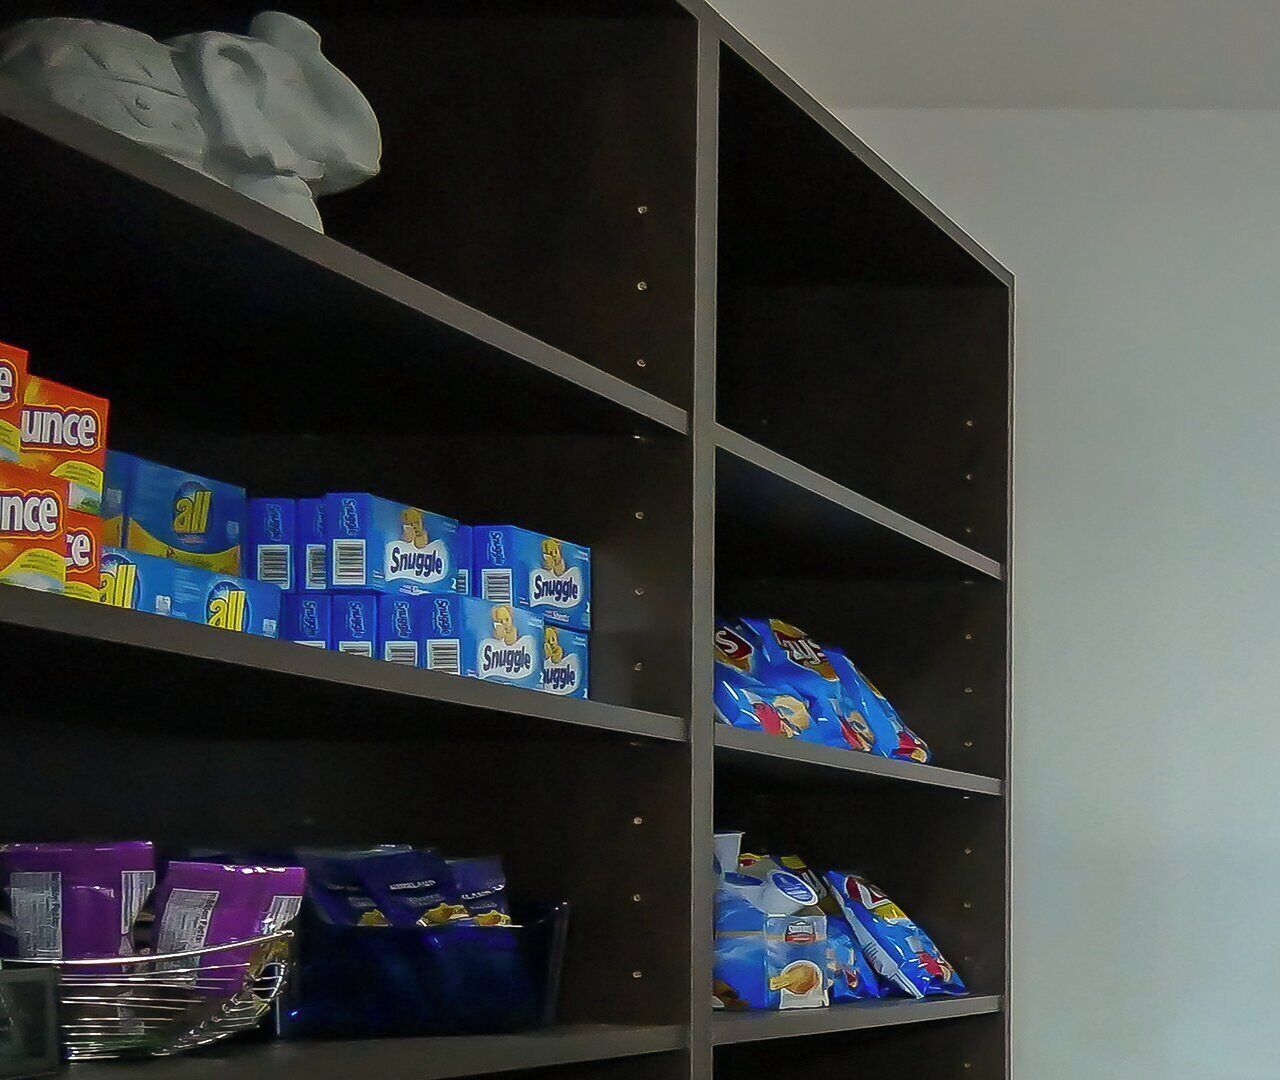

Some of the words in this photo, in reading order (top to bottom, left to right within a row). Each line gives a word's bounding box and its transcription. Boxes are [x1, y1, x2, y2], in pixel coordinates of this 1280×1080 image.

[173, 491, 212, 534] all
[390, 546, 443, 578] Snuggle
[534, 574, 579, 602] Snuggle
[483, 645, 531, 674] Snuggle
